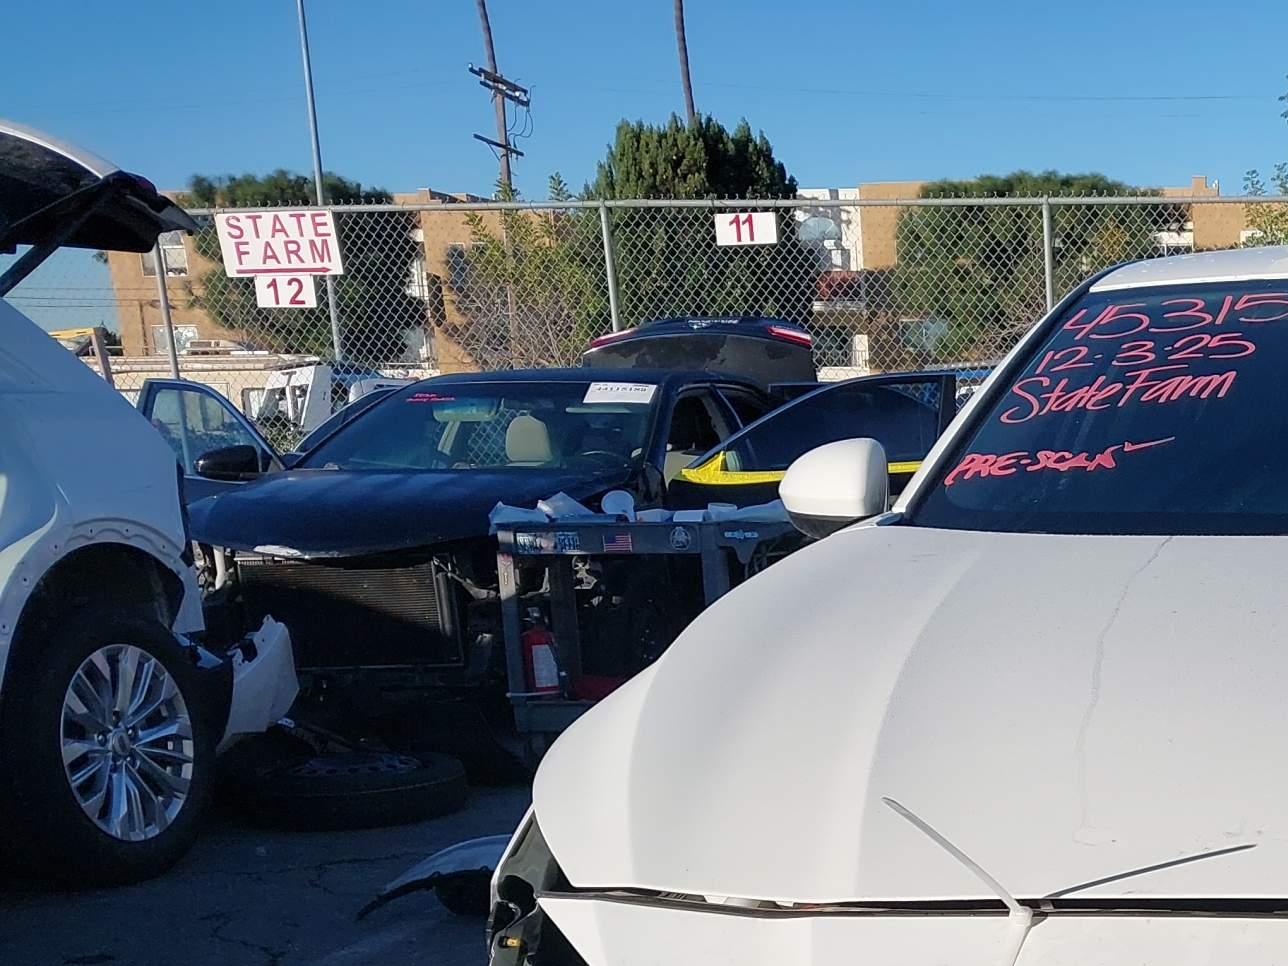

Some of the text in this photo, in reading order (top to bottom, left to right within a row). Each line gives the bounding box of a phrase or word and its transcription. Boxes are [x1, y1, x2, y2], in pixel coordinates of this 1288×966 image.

[225, 213, 331, 239] STATE
[729, 214, 754, 242] 11
[234, 239, 332, 265] FARM
[267, 278, 306, 305] 12
